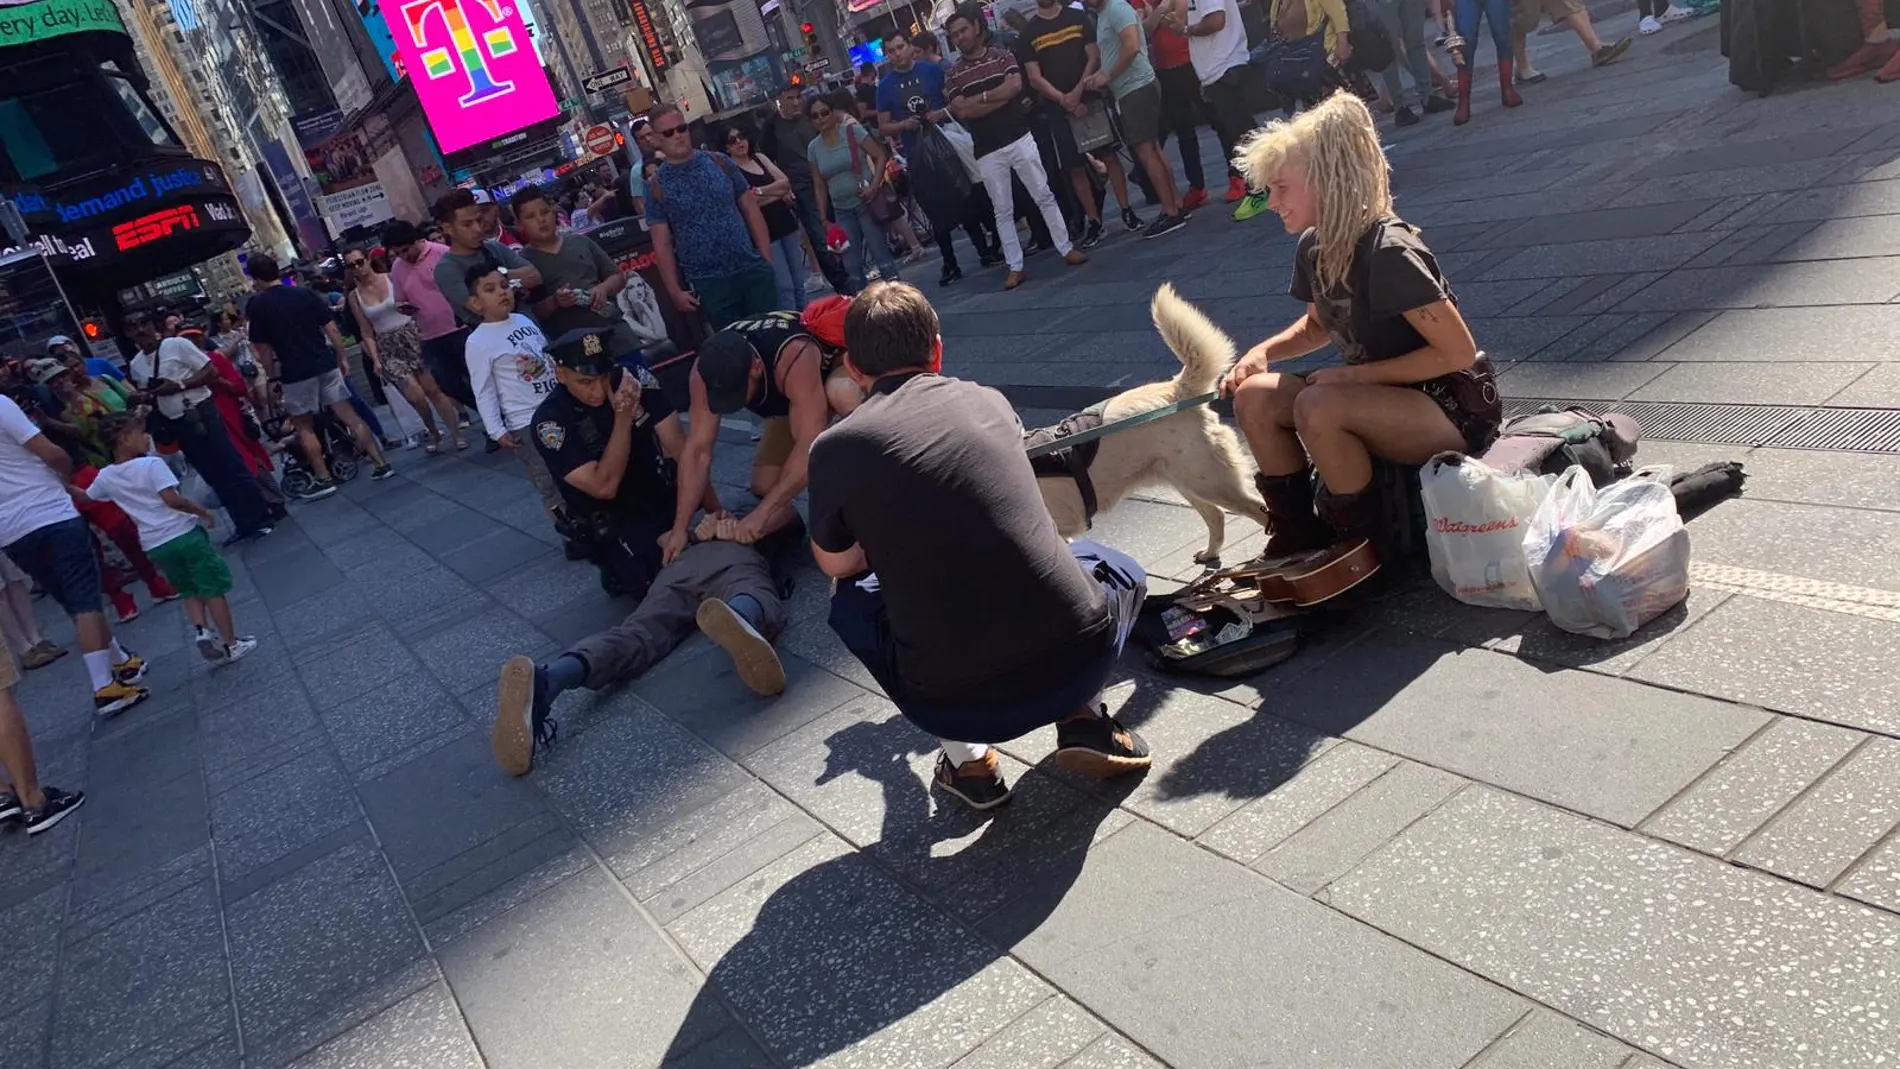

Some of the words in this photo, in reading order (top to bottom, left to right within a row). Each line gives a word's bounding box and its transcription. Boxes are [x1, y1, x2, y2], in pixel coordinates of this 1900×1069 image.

[591, 79, 604, 89] ONE
[609, 71, 624, 83] WAY
[111, 204, 200, 251] ESPN
[1433, 515, 1519, 537] Walgreens
